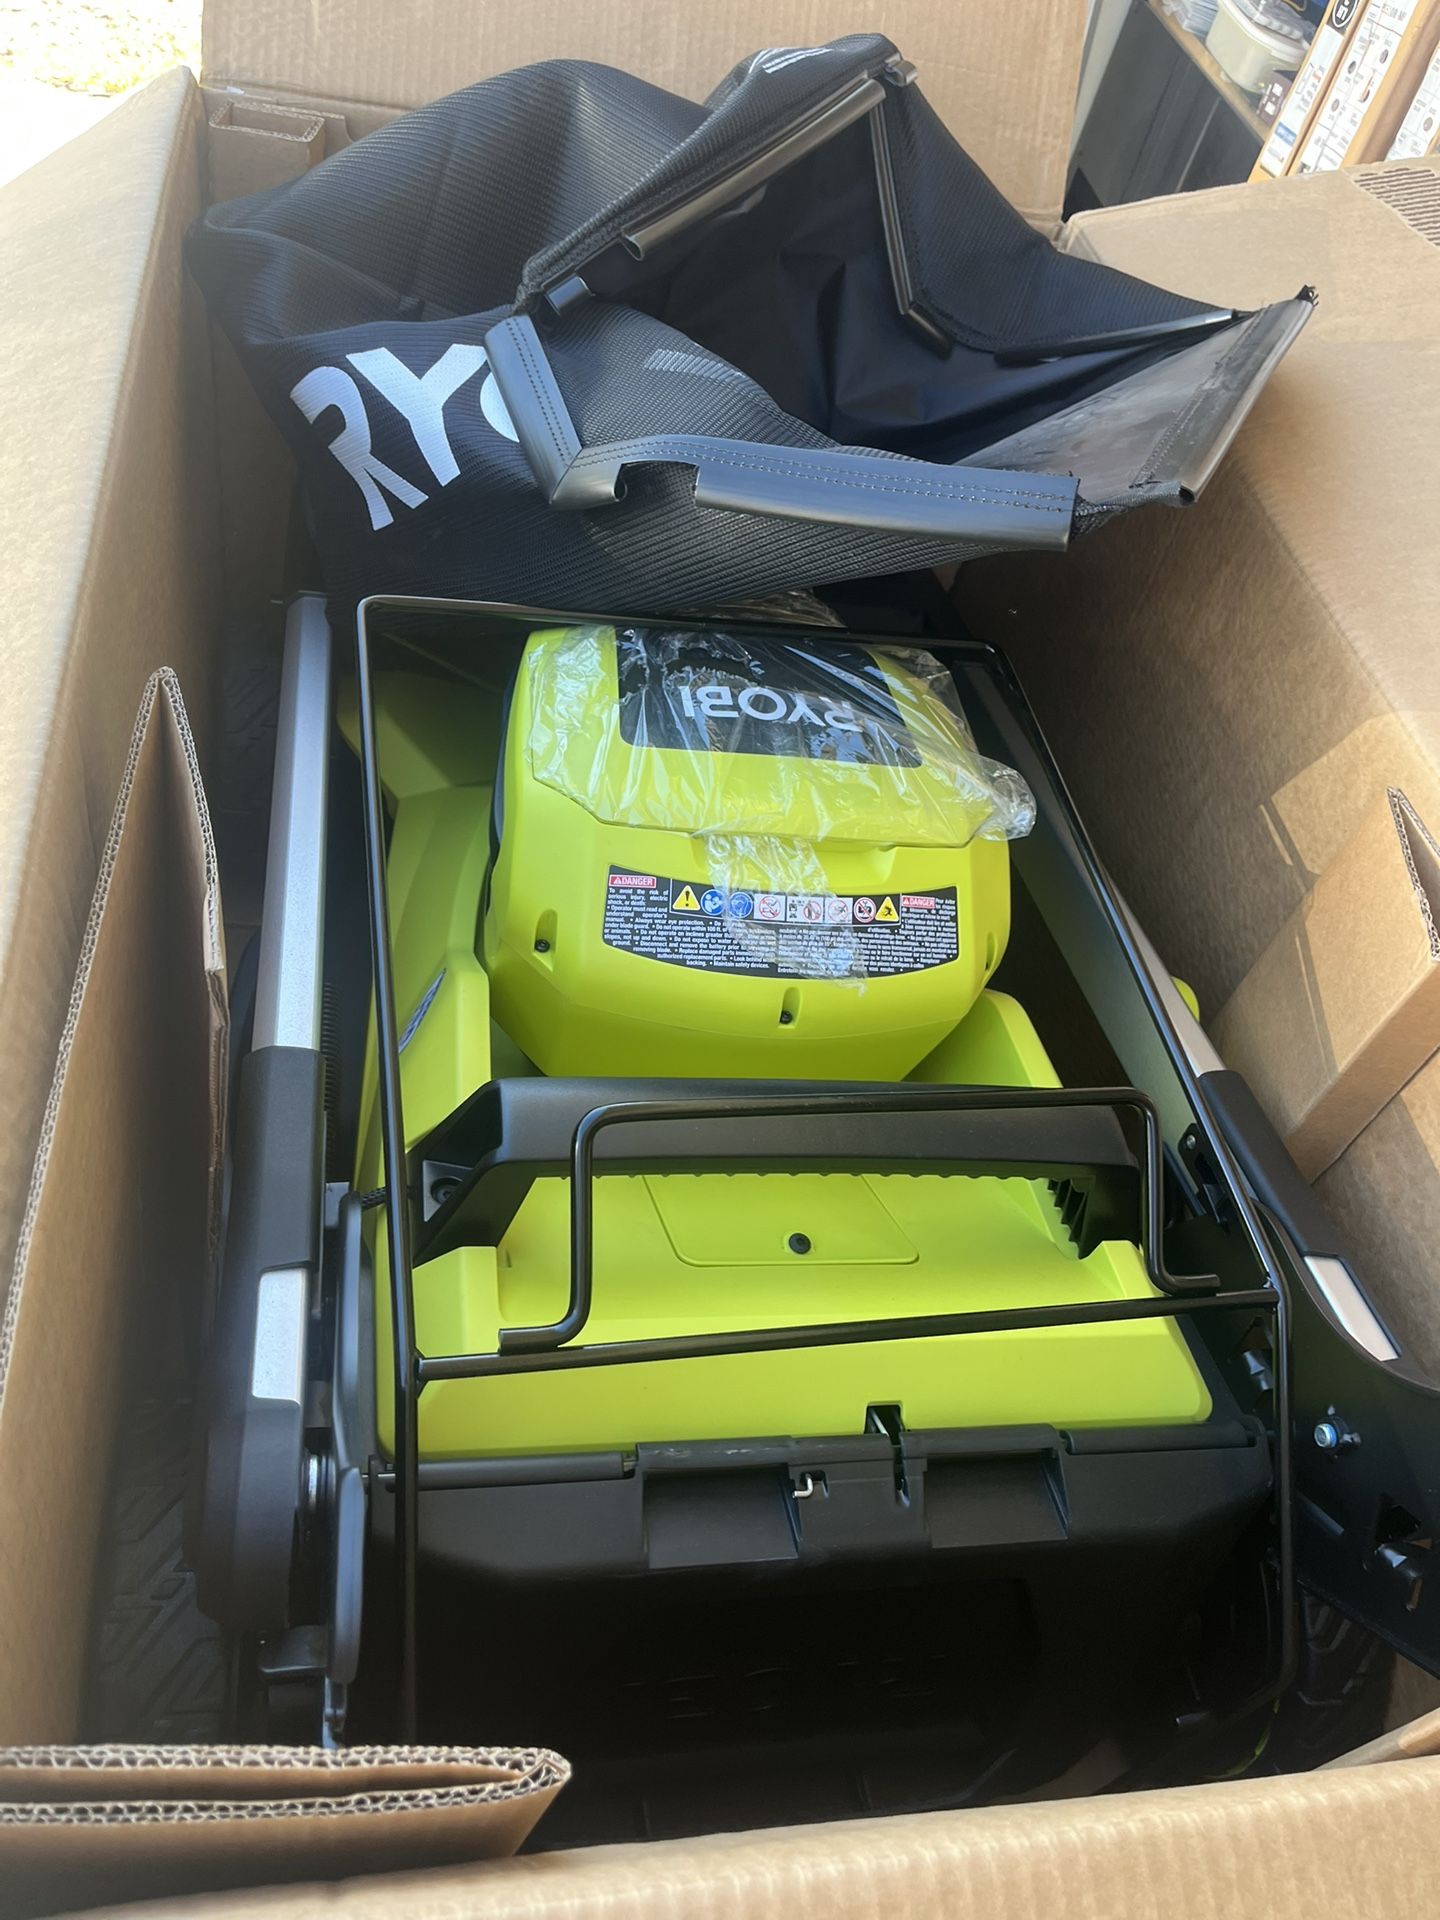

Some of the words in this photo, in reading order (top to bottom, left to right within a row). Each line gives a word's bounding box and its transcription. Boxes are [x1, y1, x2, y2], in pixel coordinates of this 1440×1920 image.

[679, 685, 863, 733] RYOBI
[621, 877, 653, 886] DANGER
[910, 898, 934, 907] DANGER
